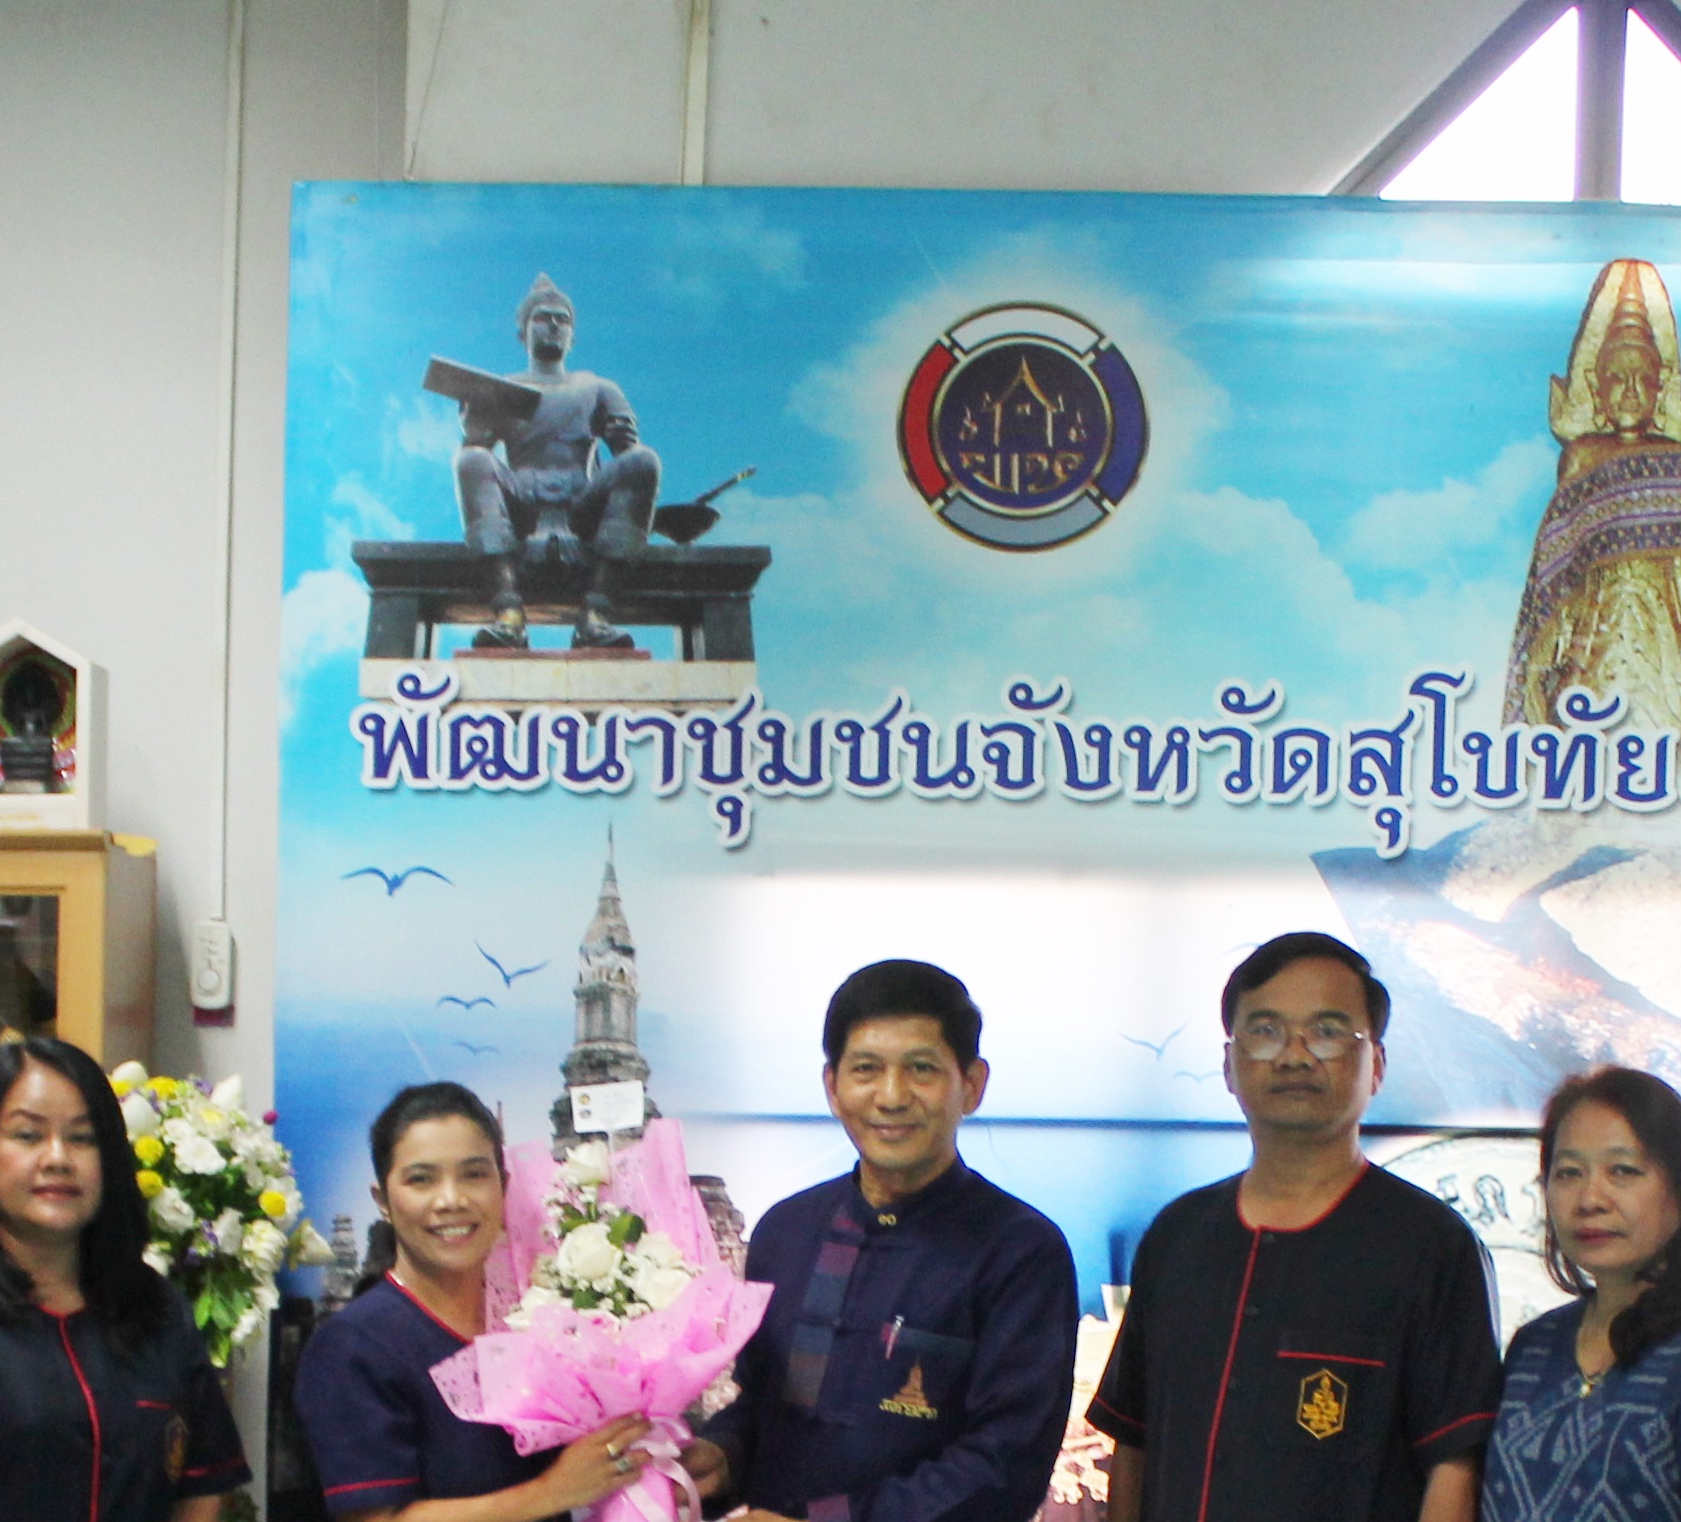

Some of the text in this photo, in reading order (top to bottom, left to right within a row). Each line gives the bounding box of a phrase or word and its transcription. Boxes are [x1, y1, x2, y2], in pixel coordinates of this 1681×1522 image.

[356, 669, 1680, 850] พัฒนาชุมชนจังหวัดสุโขทัย
